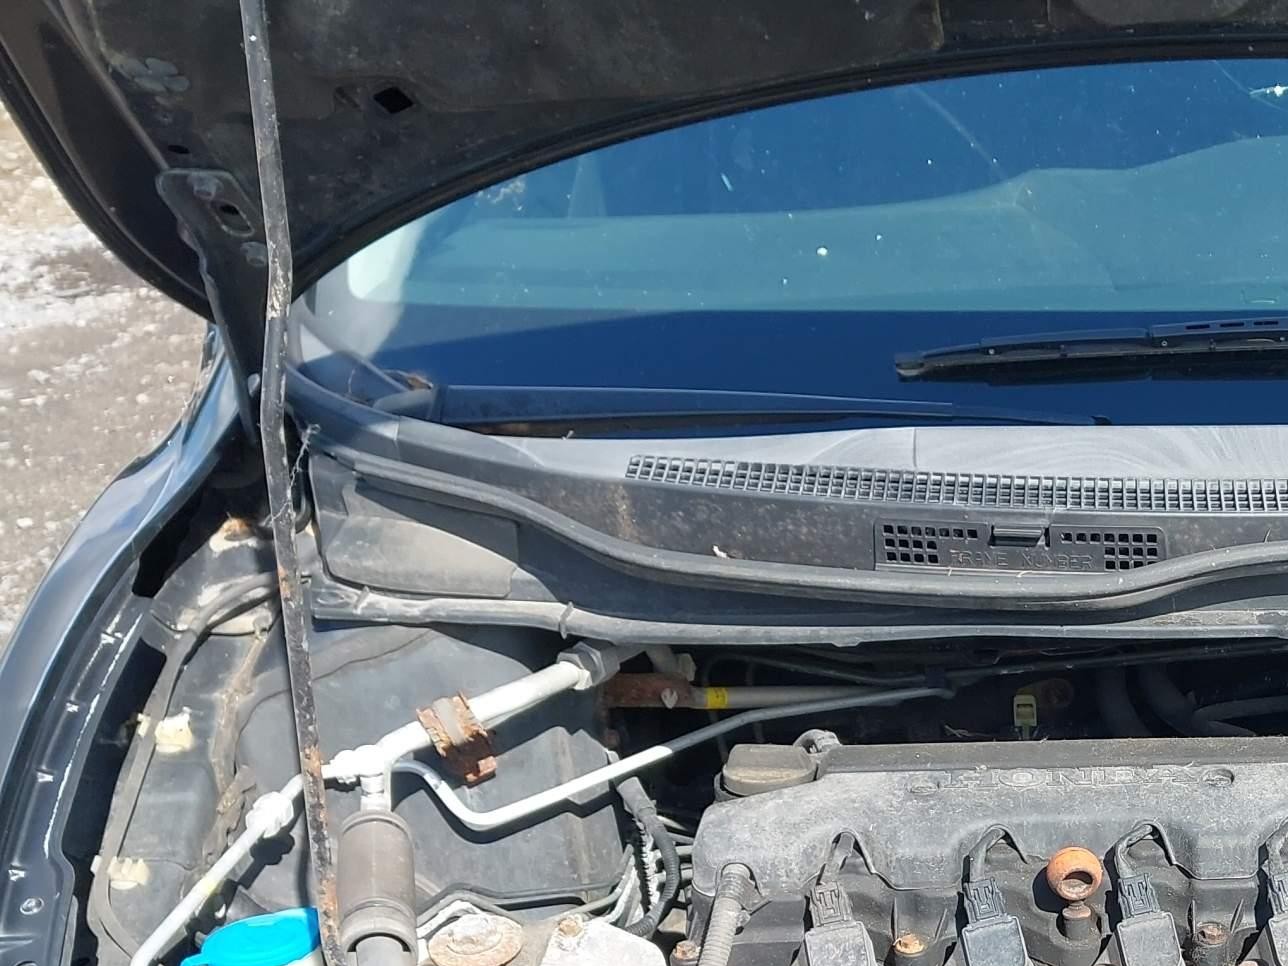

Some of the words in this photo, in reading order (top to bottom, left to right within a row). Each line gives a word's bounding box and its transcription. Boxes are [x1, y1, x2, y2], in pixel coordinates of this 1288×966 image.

[950, 550, 1008, 566] FRAME
[1021, 552, 1094, 569] NUMBER
[944, 766, 1199, 789] HONDA
